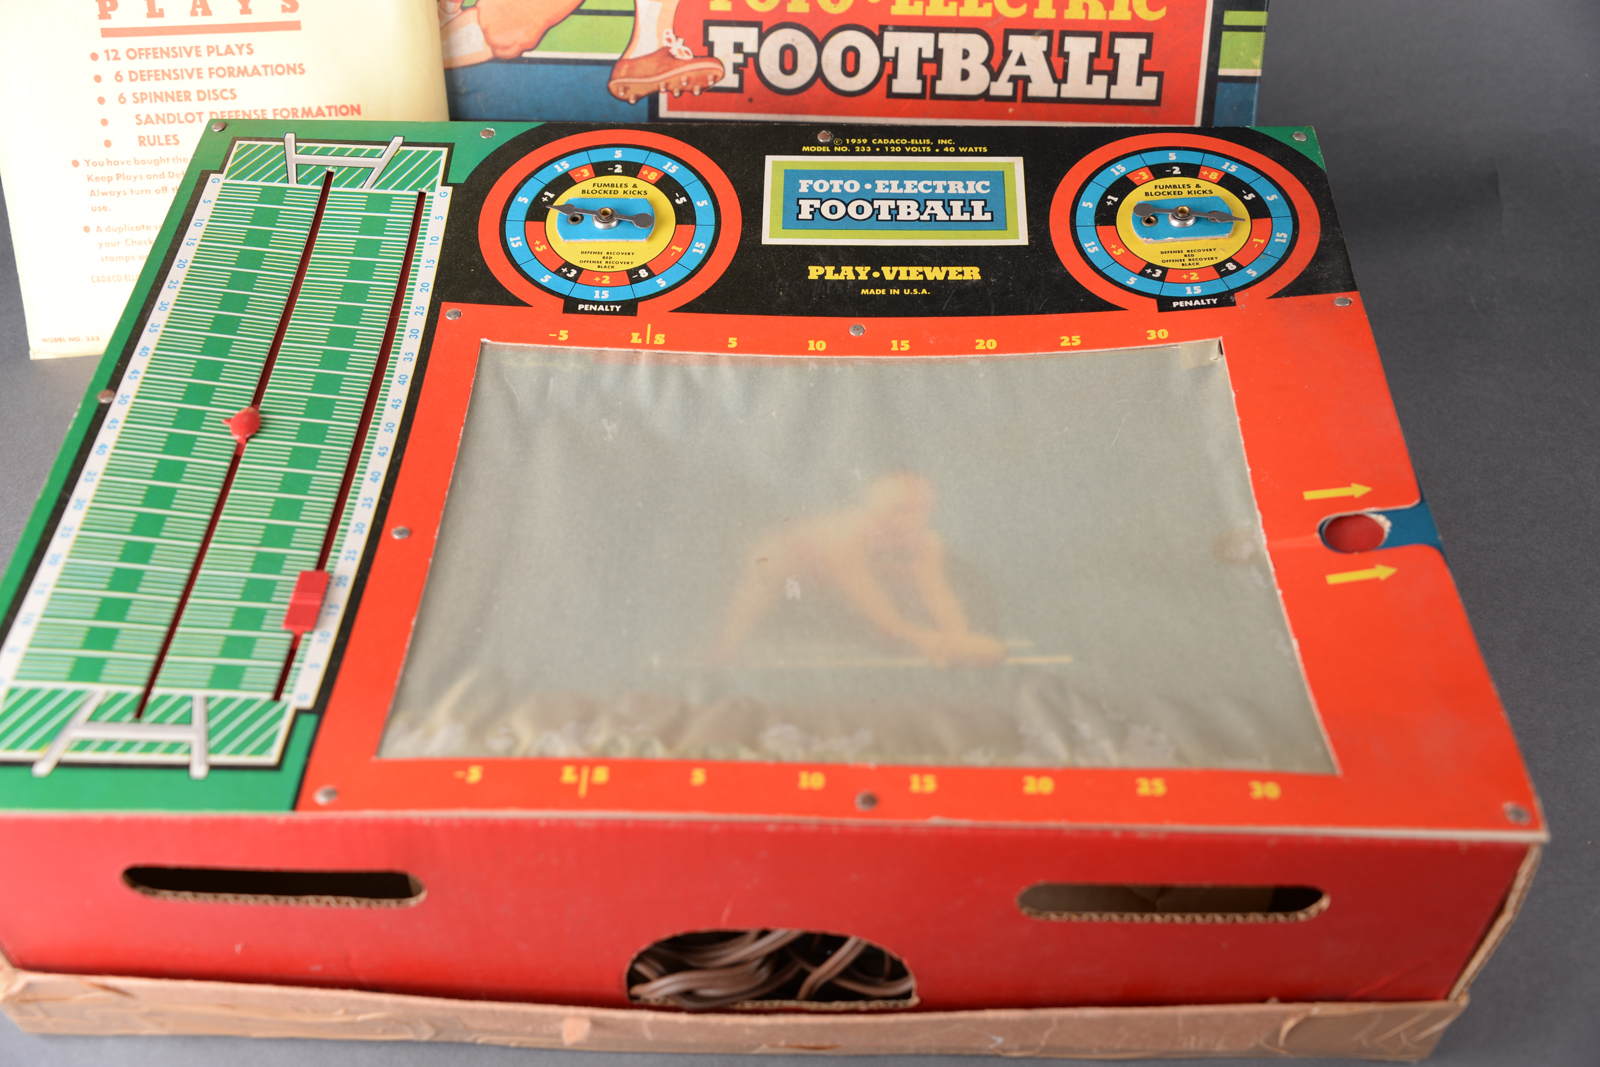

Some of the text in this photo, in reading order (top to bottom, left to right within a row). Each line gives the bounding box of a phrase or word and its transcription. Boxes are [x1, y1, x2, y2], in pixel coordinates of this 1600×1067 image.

[104, 43, 254, 61] 12 OFFENSIVE PLAYS
[704, 21, 1163, 105] FOOTBALL
[114, 63, 306, 82] 6 DEFENSIVE FORMATIONS
[118, 88, 237, 105] 6 SPINNER DISCS
[135, 104, 361, 126] SANDLOT DEFENSE FORMATION
[138, 134, 180, 147] RULES
[871, 138, 933, 146] CADACO-ELLIS,
[84, 155, 188, 167] You have bought the
[554, 161, 570, 172] 15
[662, 161, 678, 174] 15
[1110, 164, 1126, 175] 15
[1222, 162, 1238, 172] 15
[87, 171, 165, 184] Keep Plays and
[89, 188, 127, 198] Always
[130, 188, 151, 196] turn
[155, 186, 168, 194] off
[799, 179, 990, 194] FOTO ELECTRIC
[518, 196, 528, 204] 5
[1266, 193, 1278, 201] 5
[91, 204, 111, 213] use.
[696, 199, 707, 208] 5
[796, 198, 993, 222] FOOTBALL
[105, 223, 152, 234] duplicate
[194, 218, 204, 228] 10
[186, 238, 197, 246] 15
[430, 236, 440, 246] 10
[509, 236, 522, 248] 15
[1275, 232, 1287, 243] 15
[98, 240, 121, 249] your
[693, 242, 706, 254] 15
[1084, 241, 1099, 253] 15
[101, 252, 135, 262] stamps
[176, 259, 188, 269] 20
[425, 259, 435, 269] 15
[808, 265, 982, 281] PLAY VIEWER
[1246, 268, 1258, 277] 5
[540, 274, 552, 284] 5
[656, 278, 666, 288] 5
[1126, 276, 1138, 285] 5
[168, 280, 179, 290] 25
[420, 282, 430, 292] 20
[1185, 286, 1202, 294] 15
[594, 290, 609, 298] 15
[158, 301, 170, 312] 30
[1172, 298, 1218, 308] PENALTY
[414, 305, 425, 316] 25
[149, 323, 160, 333] 35
[409, 328, 420, 340] 30
[549, 330, 569, 341] -5
[728, 337, 738, 348] 5
[808, 340, 826, 351] 10
[891, 340, 910, 351] 15
[975, 339, 997, 350] 20
[1060, 335, 1081, 346] 25
[1147, 329, 1168, 340] 30
[404, 352, 414, 362] 35
[398, 374, 408, 386] 40
[391, 398, 402, 410] 45
[384, 422, 396, 434] 50
[378, 446, 389, 458] 45
[370, 471, 381, 483] 40
[690, 767, 707, 787] 5
[798, 770, 826, 790] 10
[909, 773, 938, 794] 15
[1022, 775, 1055, 796] 20
[1135, 777, 1168, 797] 25
[1248, 780, 1281, 801] 30
